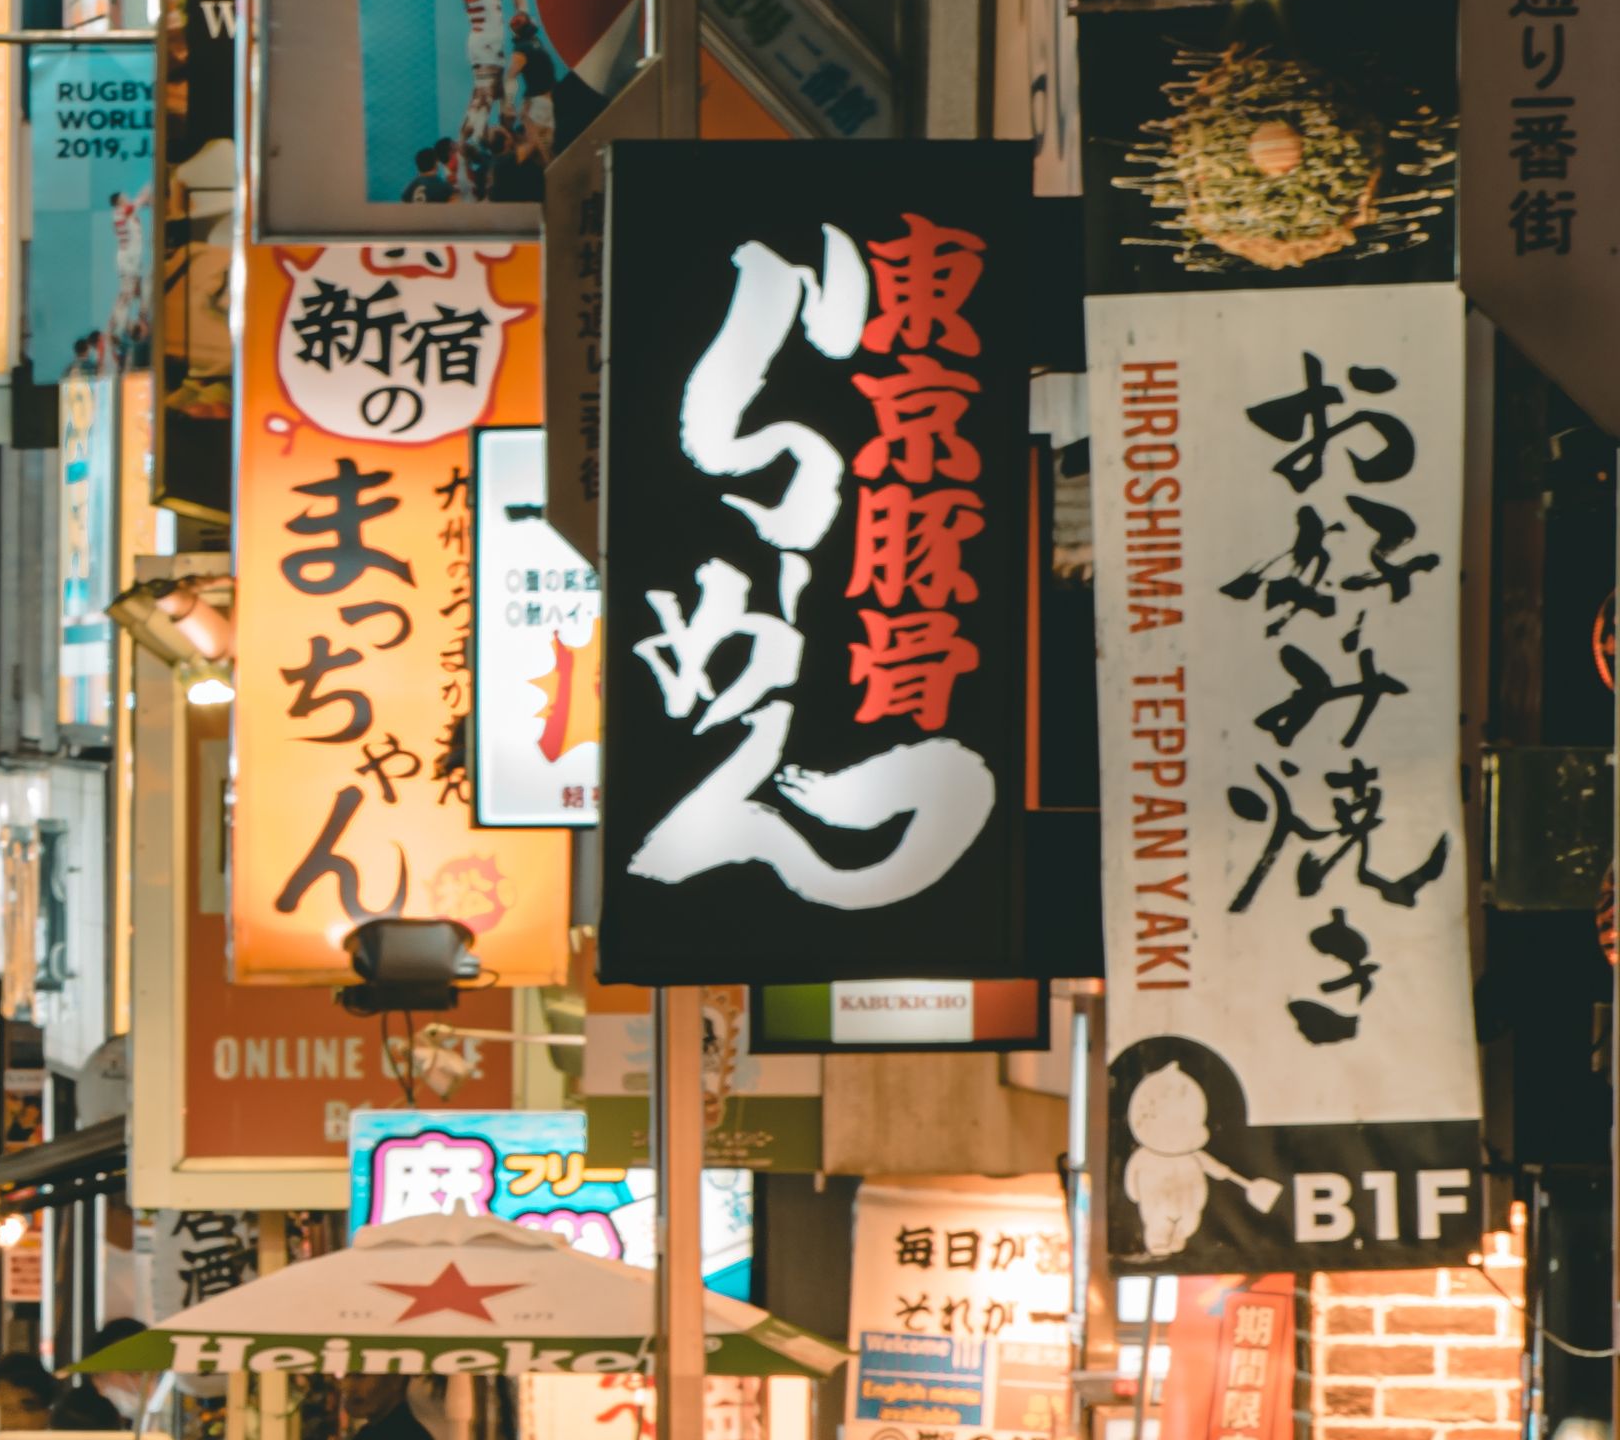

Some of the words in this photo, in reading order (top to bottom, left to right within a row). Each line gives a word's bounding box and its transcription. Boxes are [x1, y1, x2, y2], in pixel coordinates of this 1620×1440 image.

[56, 79, 153, 107] RUGBY
[290, 276, 493, 435] 新宿の
[843, 211, 988, 734] 東京豚骨
[1120, 360, 1184, 634] HIROSHIMA
[273, 456, 424, 922] まっちゃん
[1218, 348, 1452, 1048] お好み焼き
[1130, 666, 1192, 994] TEPPANYAKI
[212, 1036, 366, 1081] ONLINE
[839, 993, 968, 1012] KABUKICHO
[503, 1152, 628, 1197] フリー
[1291, 1166, 1472, 1244] B1F
